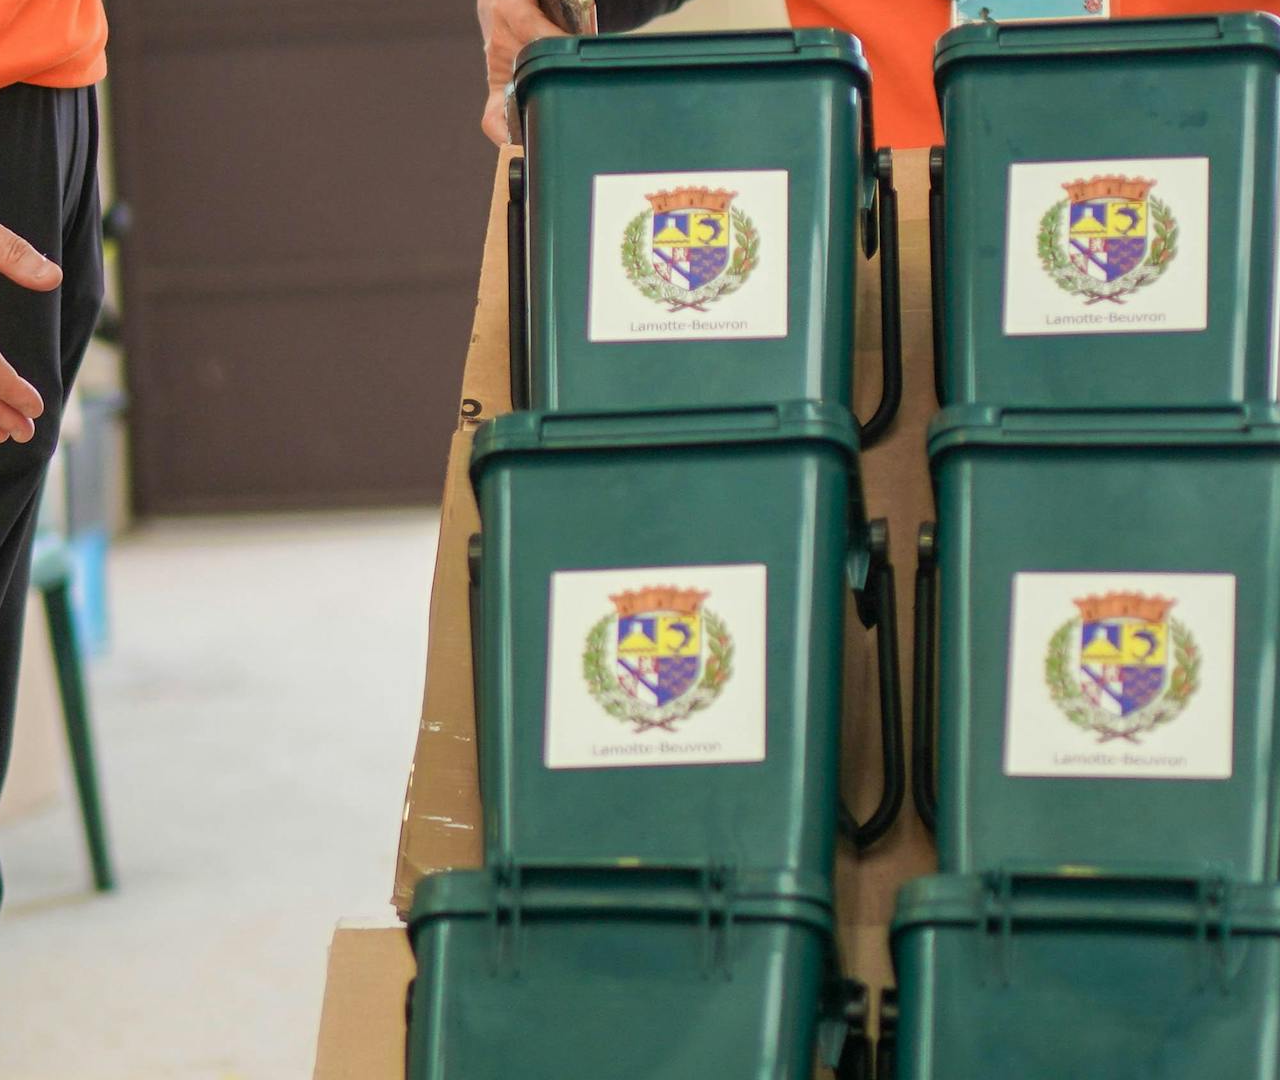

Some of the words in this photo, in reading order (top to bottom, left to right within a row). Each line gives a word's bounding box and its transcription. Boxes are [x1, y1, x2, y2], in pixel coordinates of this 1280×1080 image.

[630, 319, 748, 333] Lamotte-Beuvron
[1045, 311, 1166, 326] Lamotte-Beuvron
[591, 740, 722, 757] Lamotte-Beuvron
[1053, 751, 1187, 767] Lamotte-Beuvron
